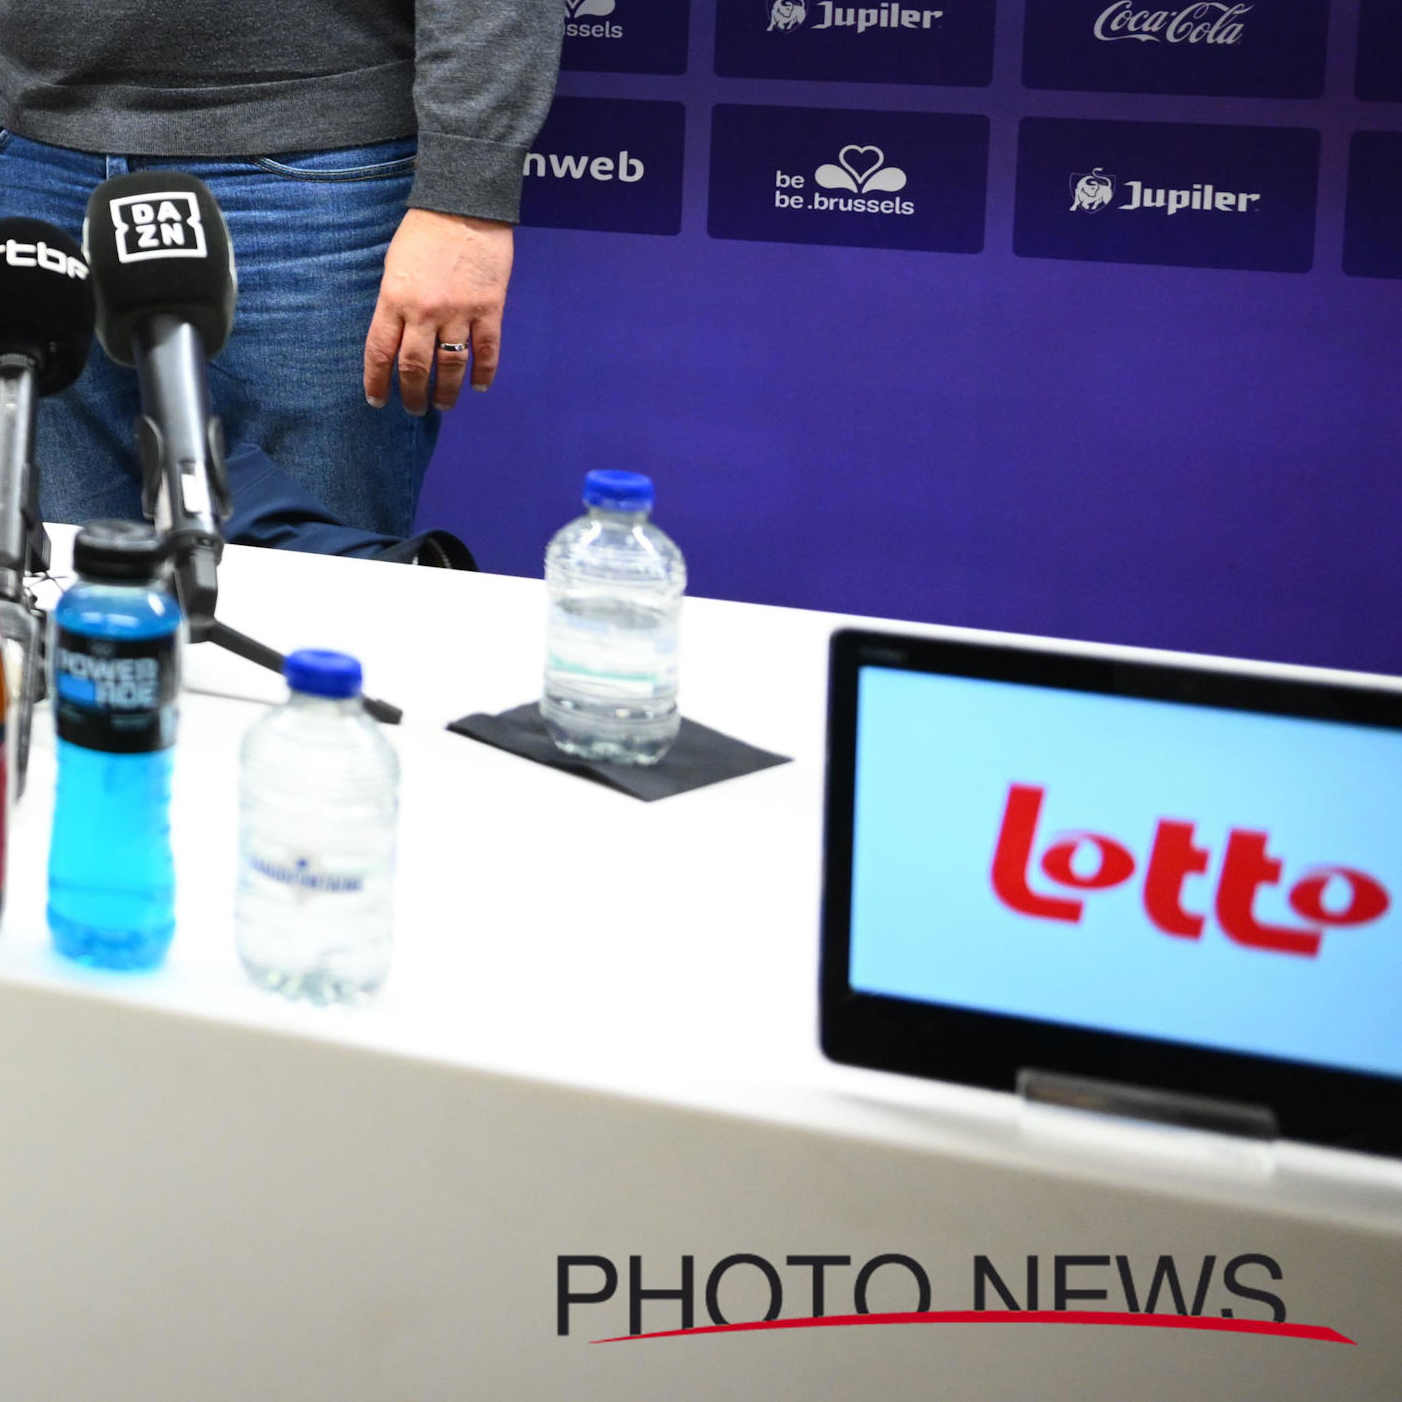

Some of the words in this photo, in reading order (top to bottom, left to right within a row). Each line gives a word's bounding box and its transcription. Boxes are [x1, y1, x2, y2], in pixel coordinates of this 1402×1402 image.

[812, 0, 944, 34] Jupiler
[1093, 0, 1256, 45] Coca-Cola
[522, 151, 646, 183] nweb
[776, 171, 805, 189] be
[1118, 180, 1261, 216] Jupiler
